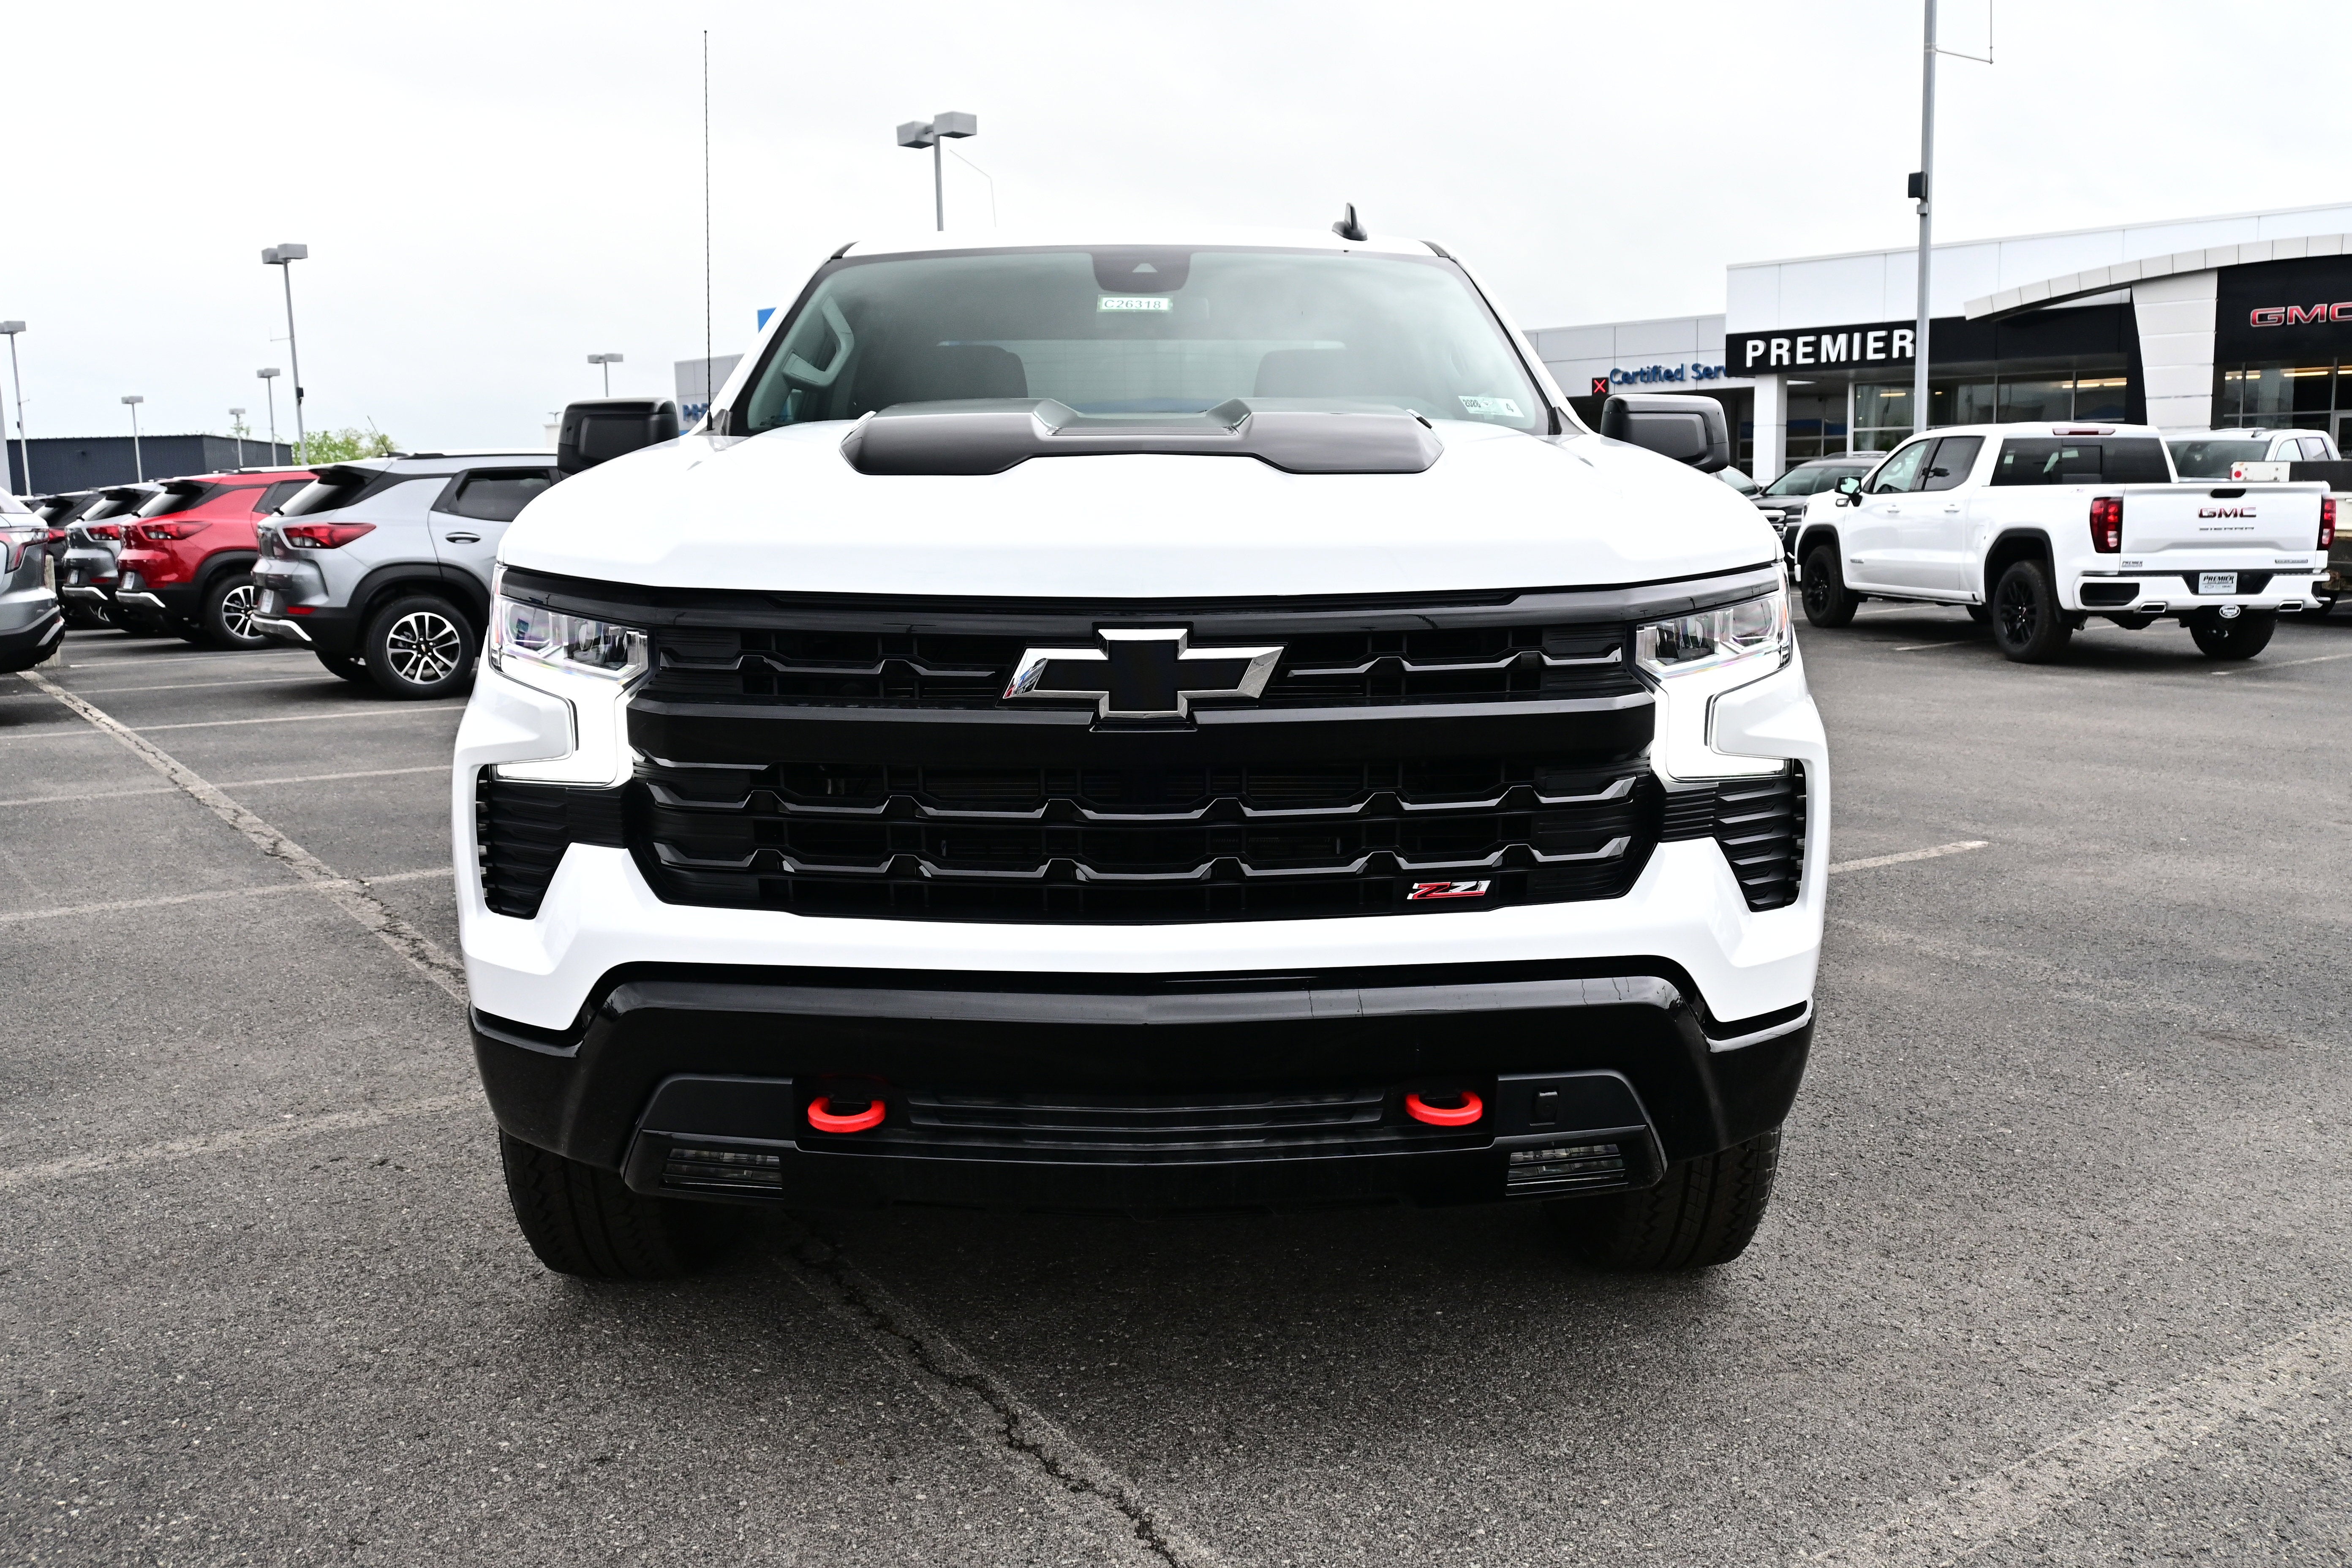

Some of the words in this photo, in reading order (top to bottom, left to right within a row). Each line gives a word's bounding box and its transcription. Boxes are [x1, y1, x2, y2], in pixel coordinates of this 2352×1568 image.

[1104, 300, 1161, 309] C26318
[2250, 302, 2352, 327] GMC
[1746, 329, 1915, 368] PREMIER
[1610, 363, 1685, 384] Certified
[1506, 403, 1514, 412] 4
[2199, 506, 2257, 518] GMC
[1407, 880, 1491, 900] Z71
